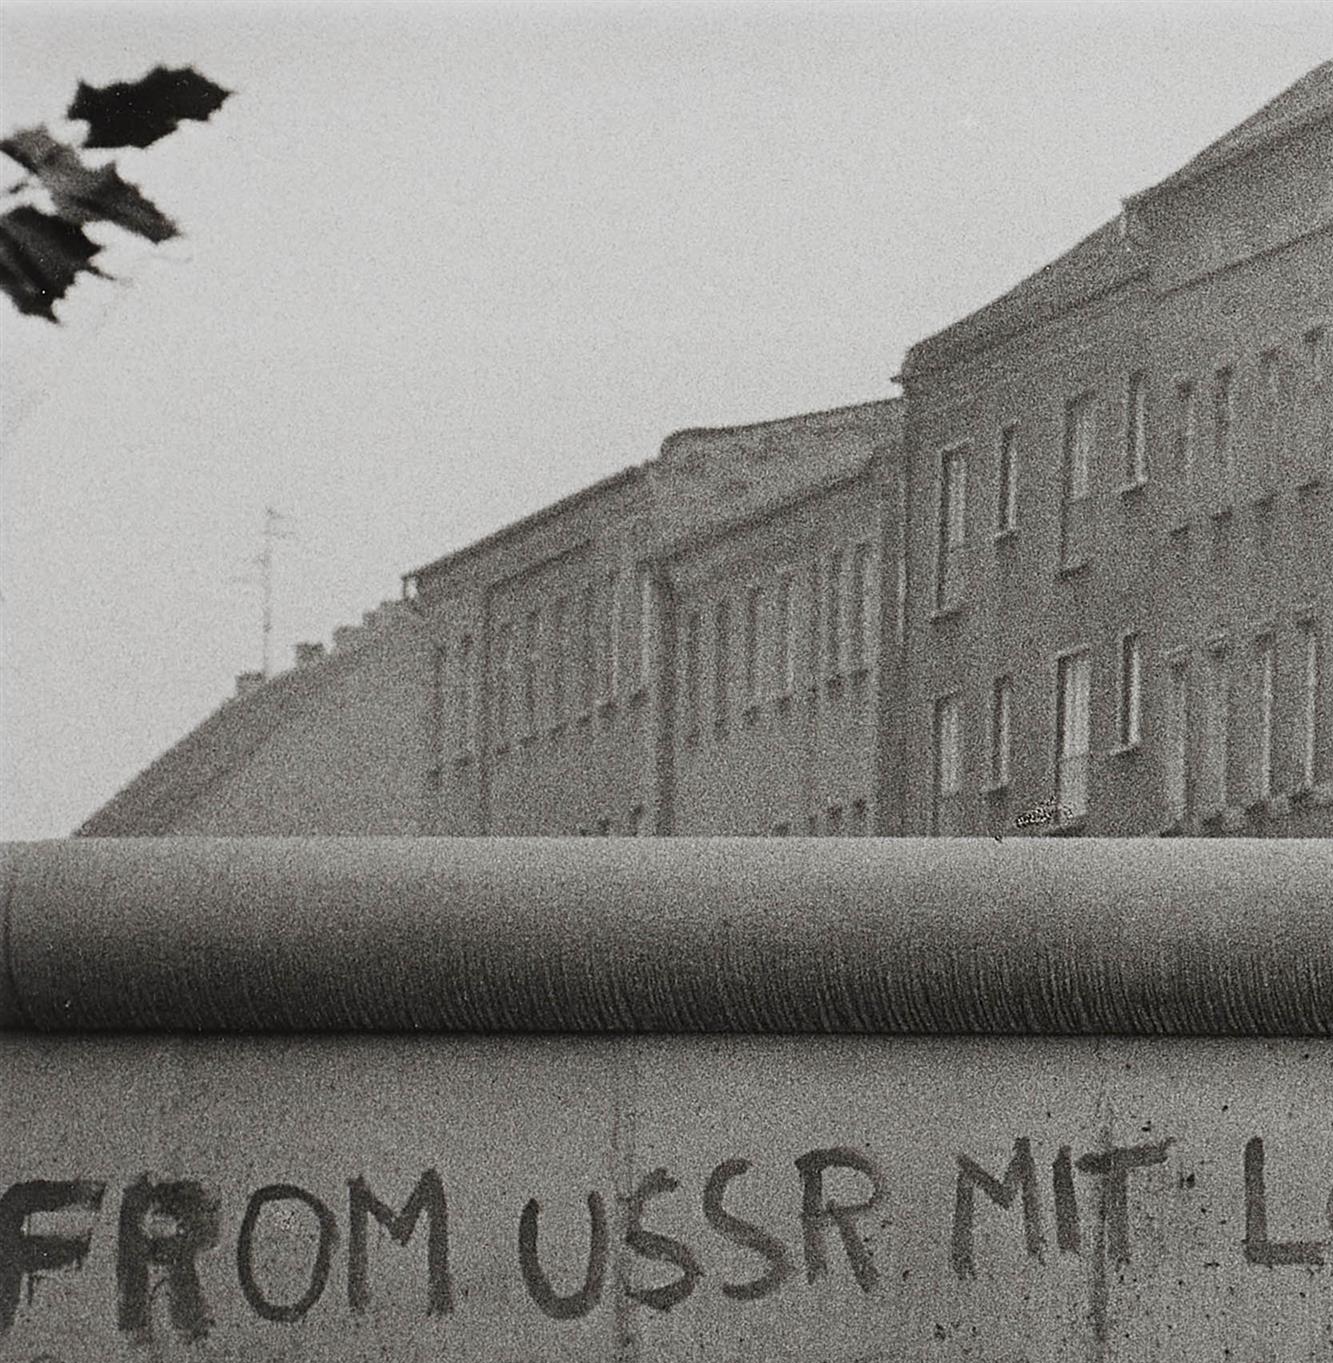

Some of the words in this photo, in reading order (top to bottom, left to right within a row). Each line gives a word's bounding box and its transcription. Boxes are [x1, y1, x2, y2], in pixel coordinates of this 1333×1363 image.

[0, 1168, 454, 1345] FROM
[518, 1147, 893, 1321] USSR
[951, 1136, 1174, 1280] MIT
